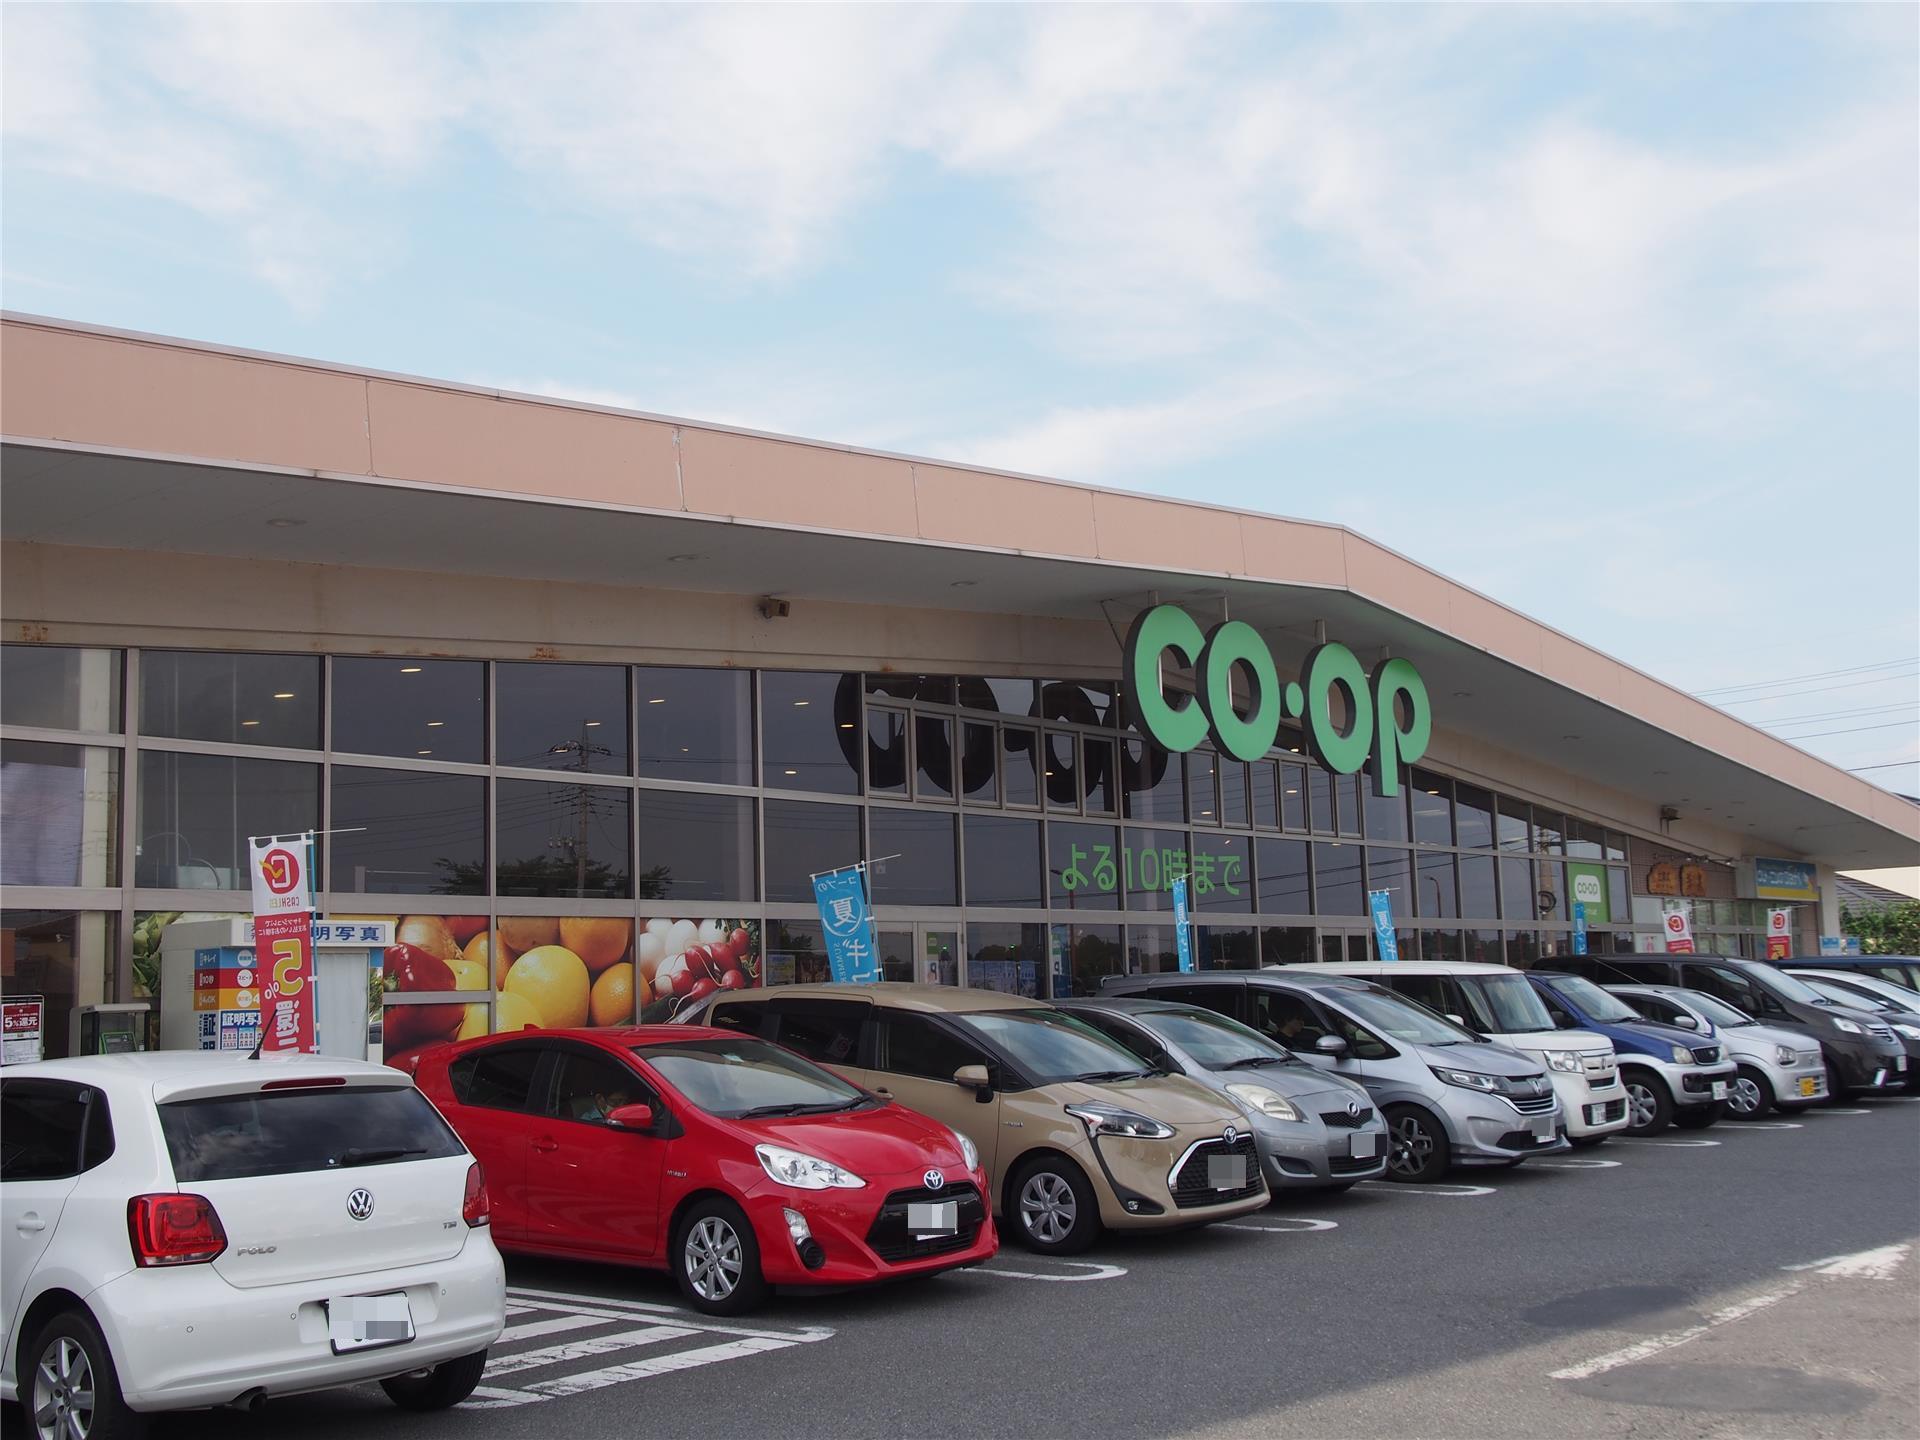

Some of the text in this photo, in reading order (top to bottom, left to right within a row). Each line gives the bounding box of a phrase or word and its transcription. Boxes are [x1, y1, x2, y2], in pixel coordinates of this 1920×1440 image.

[1062, 843, 1241, 896] よる10時まで
[237, 1246, 277, 1257] POLO
